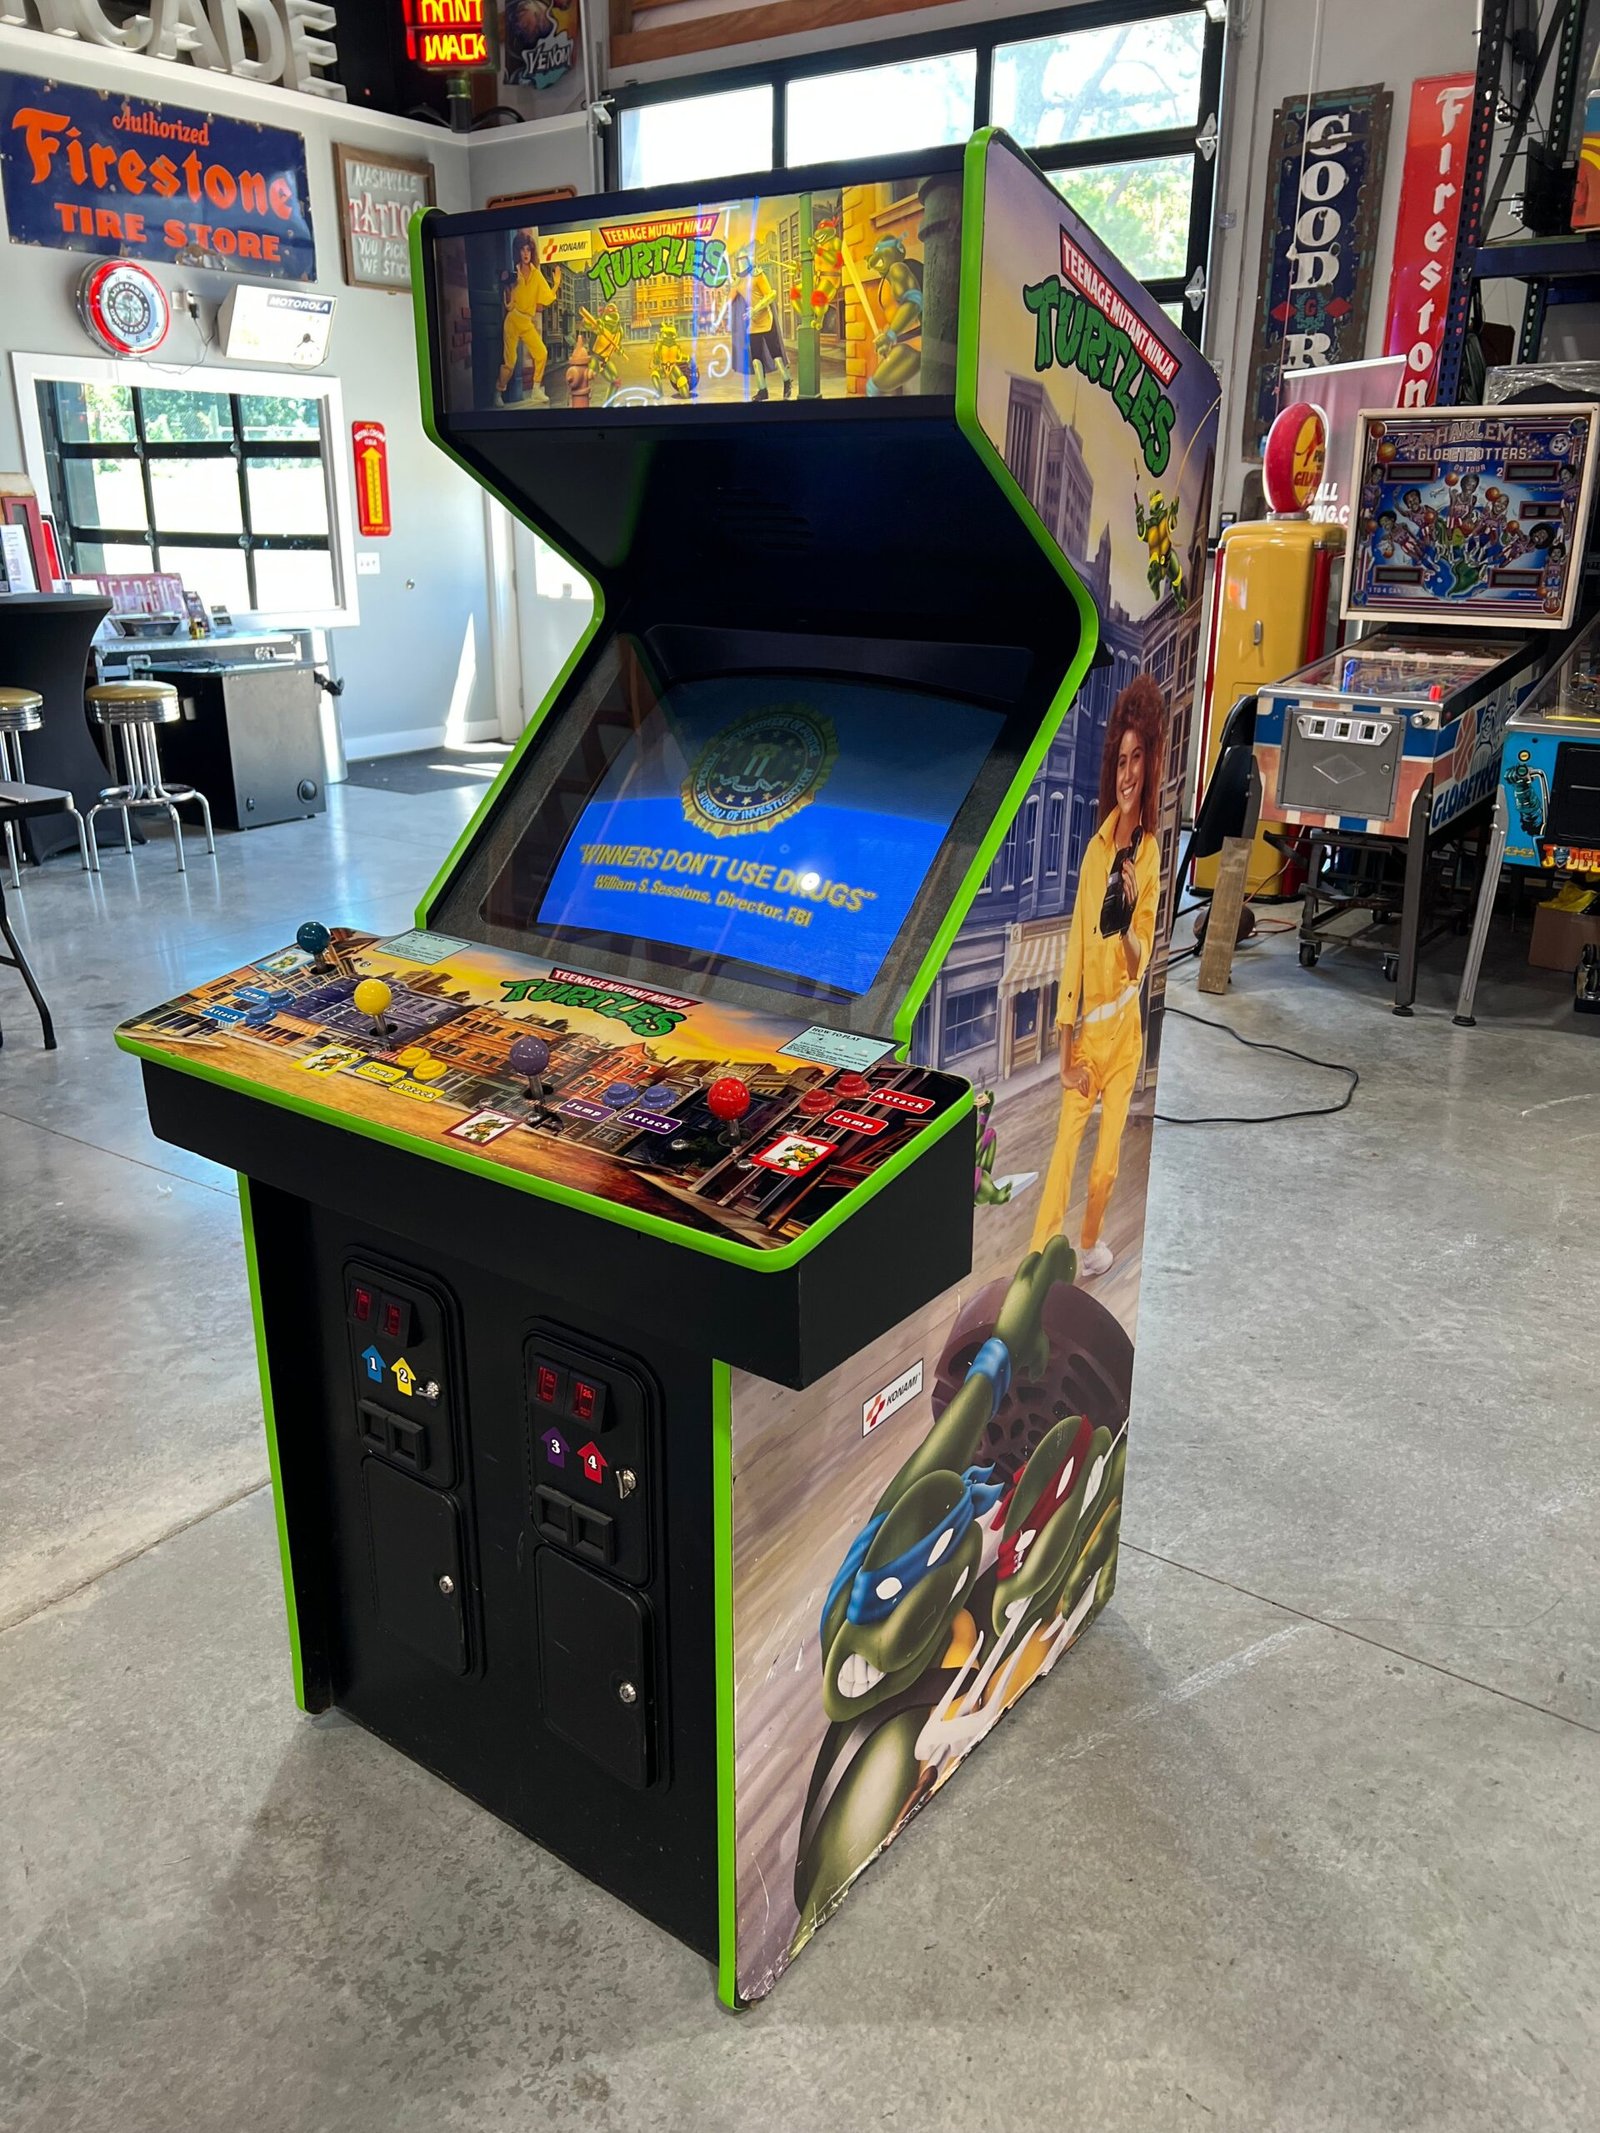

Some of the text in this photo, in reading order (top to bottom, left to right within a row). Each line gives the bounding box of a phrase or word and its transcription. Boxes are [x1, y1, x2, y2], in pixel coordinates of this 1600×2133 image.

[529, 43, 573, 75] VENOM
[112, 103, 209, 146] Authorized
[12, 107, 293, 220] Firestone
[355, 163, 418, 193] NASHVILLE
[54, 202, 281, 262] TIRE STORE
[604, 218, 714, 243] TEENAGE MUTANT NINJA
[359, 237, 378, 256] YOU
[558, 242, 586, 253] KONAMI
[361, 258, 378, 274] WE
[587, 235, 729, 301] TURTLES
[269, 296, 329, 312] MOTOROLA
[1062, 238, 1176, 382] TEENAGE MUTANT NINJA
[1023, 274, 1176, 478] TURTLES
[1435, 421, 1514, 446] HARLEM
[1417, 446, 1527, 462] GLOBETROTTERS
[1466, 463, 1486, 473] TOUR
[698, 789, 726, 819] BUREAU
[726, 809, 741, 820] OF
[740, 767, 814, 820] INVESTIGATION
[660, 848, 728, 878] DON'T
[726, 858, 777, 889] USE
[594, 874, 813, 927] William S. Sessions, Director, FBI
[241, 989, 265, 1000] Jump
[554, 969, 691, 1009] TEENAGE MUTANT NINJA
[206, 1007, 240, 1021] Attack
[500, 978, 687, 1037] TURTLES
[811, 1027, 830, 1035] HOW
[842, 1034, 862, 1042] PLAY
[363, 1064, 394, 1079] Jump
[394, 1082, 437, 1099] Attack
[874, 1092, 926, 1110] Attack
[566, 1101, 602, 1118] Jump
[624, 1111, 672, 1131] Attack
[832, 1114, 874, 1130] Jump
[369, 1357, 408, 1383] 1 2
[886, 1374, 919, 1407] KONAMI
[551, 1438, 598, 1469] 3 4
